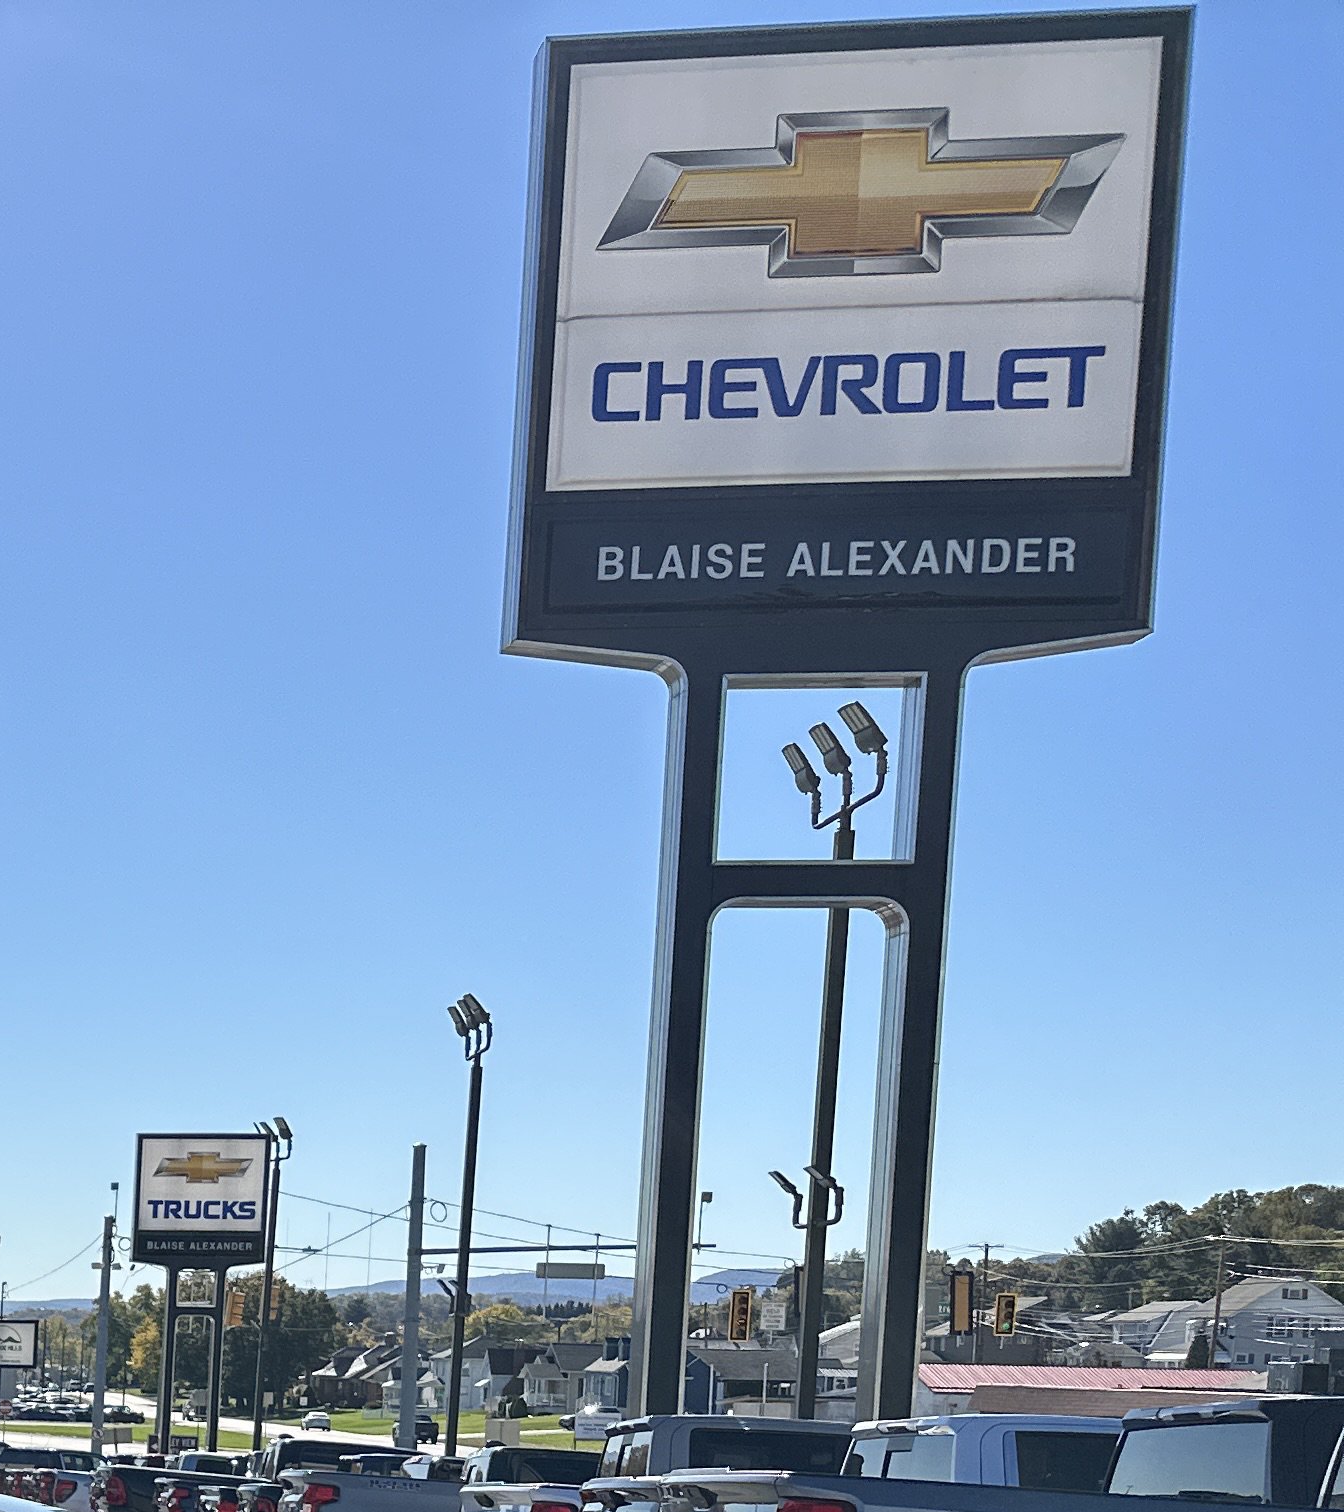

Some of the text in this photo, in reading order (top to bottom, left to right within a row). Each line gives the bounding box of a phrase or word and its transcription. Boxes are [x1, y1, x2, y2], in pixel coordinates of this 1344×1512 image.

[591, 344, 1107, 423] CHEVROLET
[596, 535, 1077, 581] BLAISE ALEXANDER
[147, 1199, 257, 1220] TRUCKS
[146, 1240, 253, 1252] BLAISE ALEXANDER
